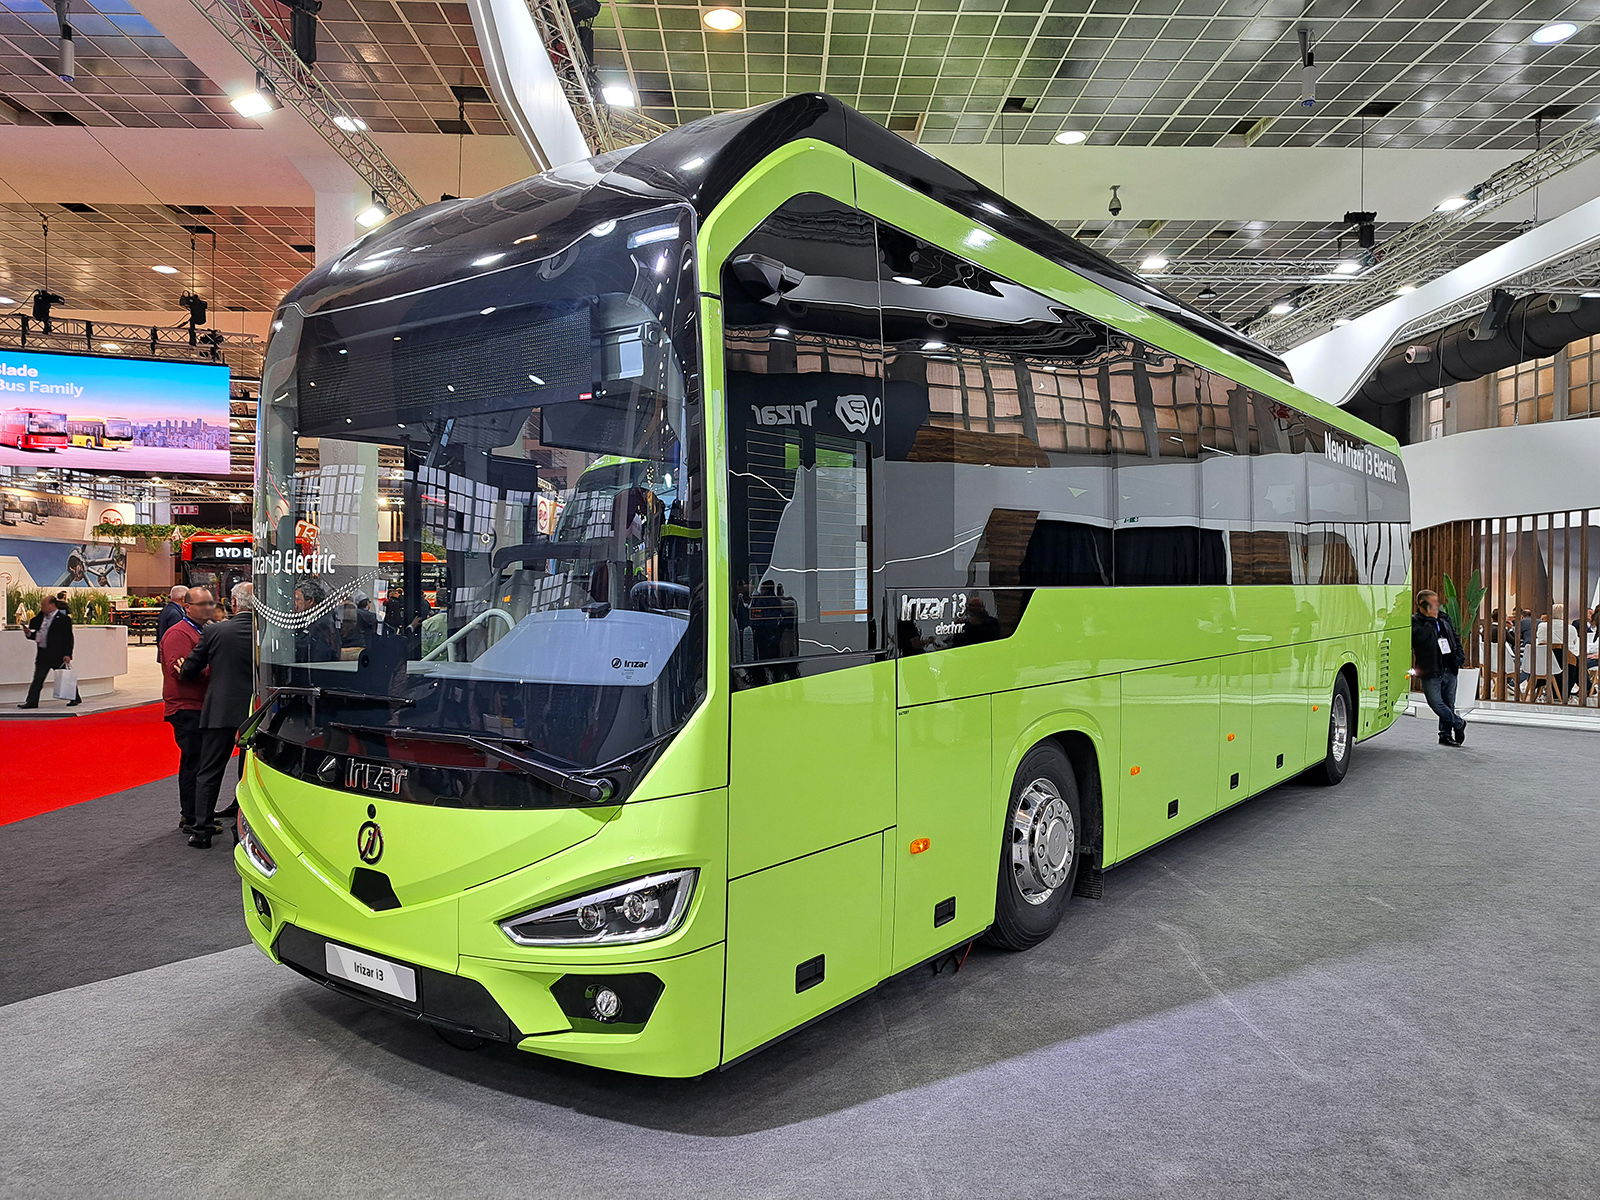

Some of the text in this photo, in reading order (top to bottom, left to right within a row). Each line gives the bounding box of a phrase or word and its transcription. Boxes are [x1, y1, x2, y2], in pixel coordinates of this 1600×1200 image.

[0, 363, 39, 378] lade
[29, 380, 84, 398] Family
[1324, 430, 1397, 484] New Irizar i3 Electric
[215, 547, 253, 558] BYD B
[284, 547, 336, 574] Electric
[901, 593, 967, 621] Irizar i3
[624, 660, 648, 668] Irizar
[344, 757, 408, 795] Irizar
[353, 961, 384, 981] Irizar i3
